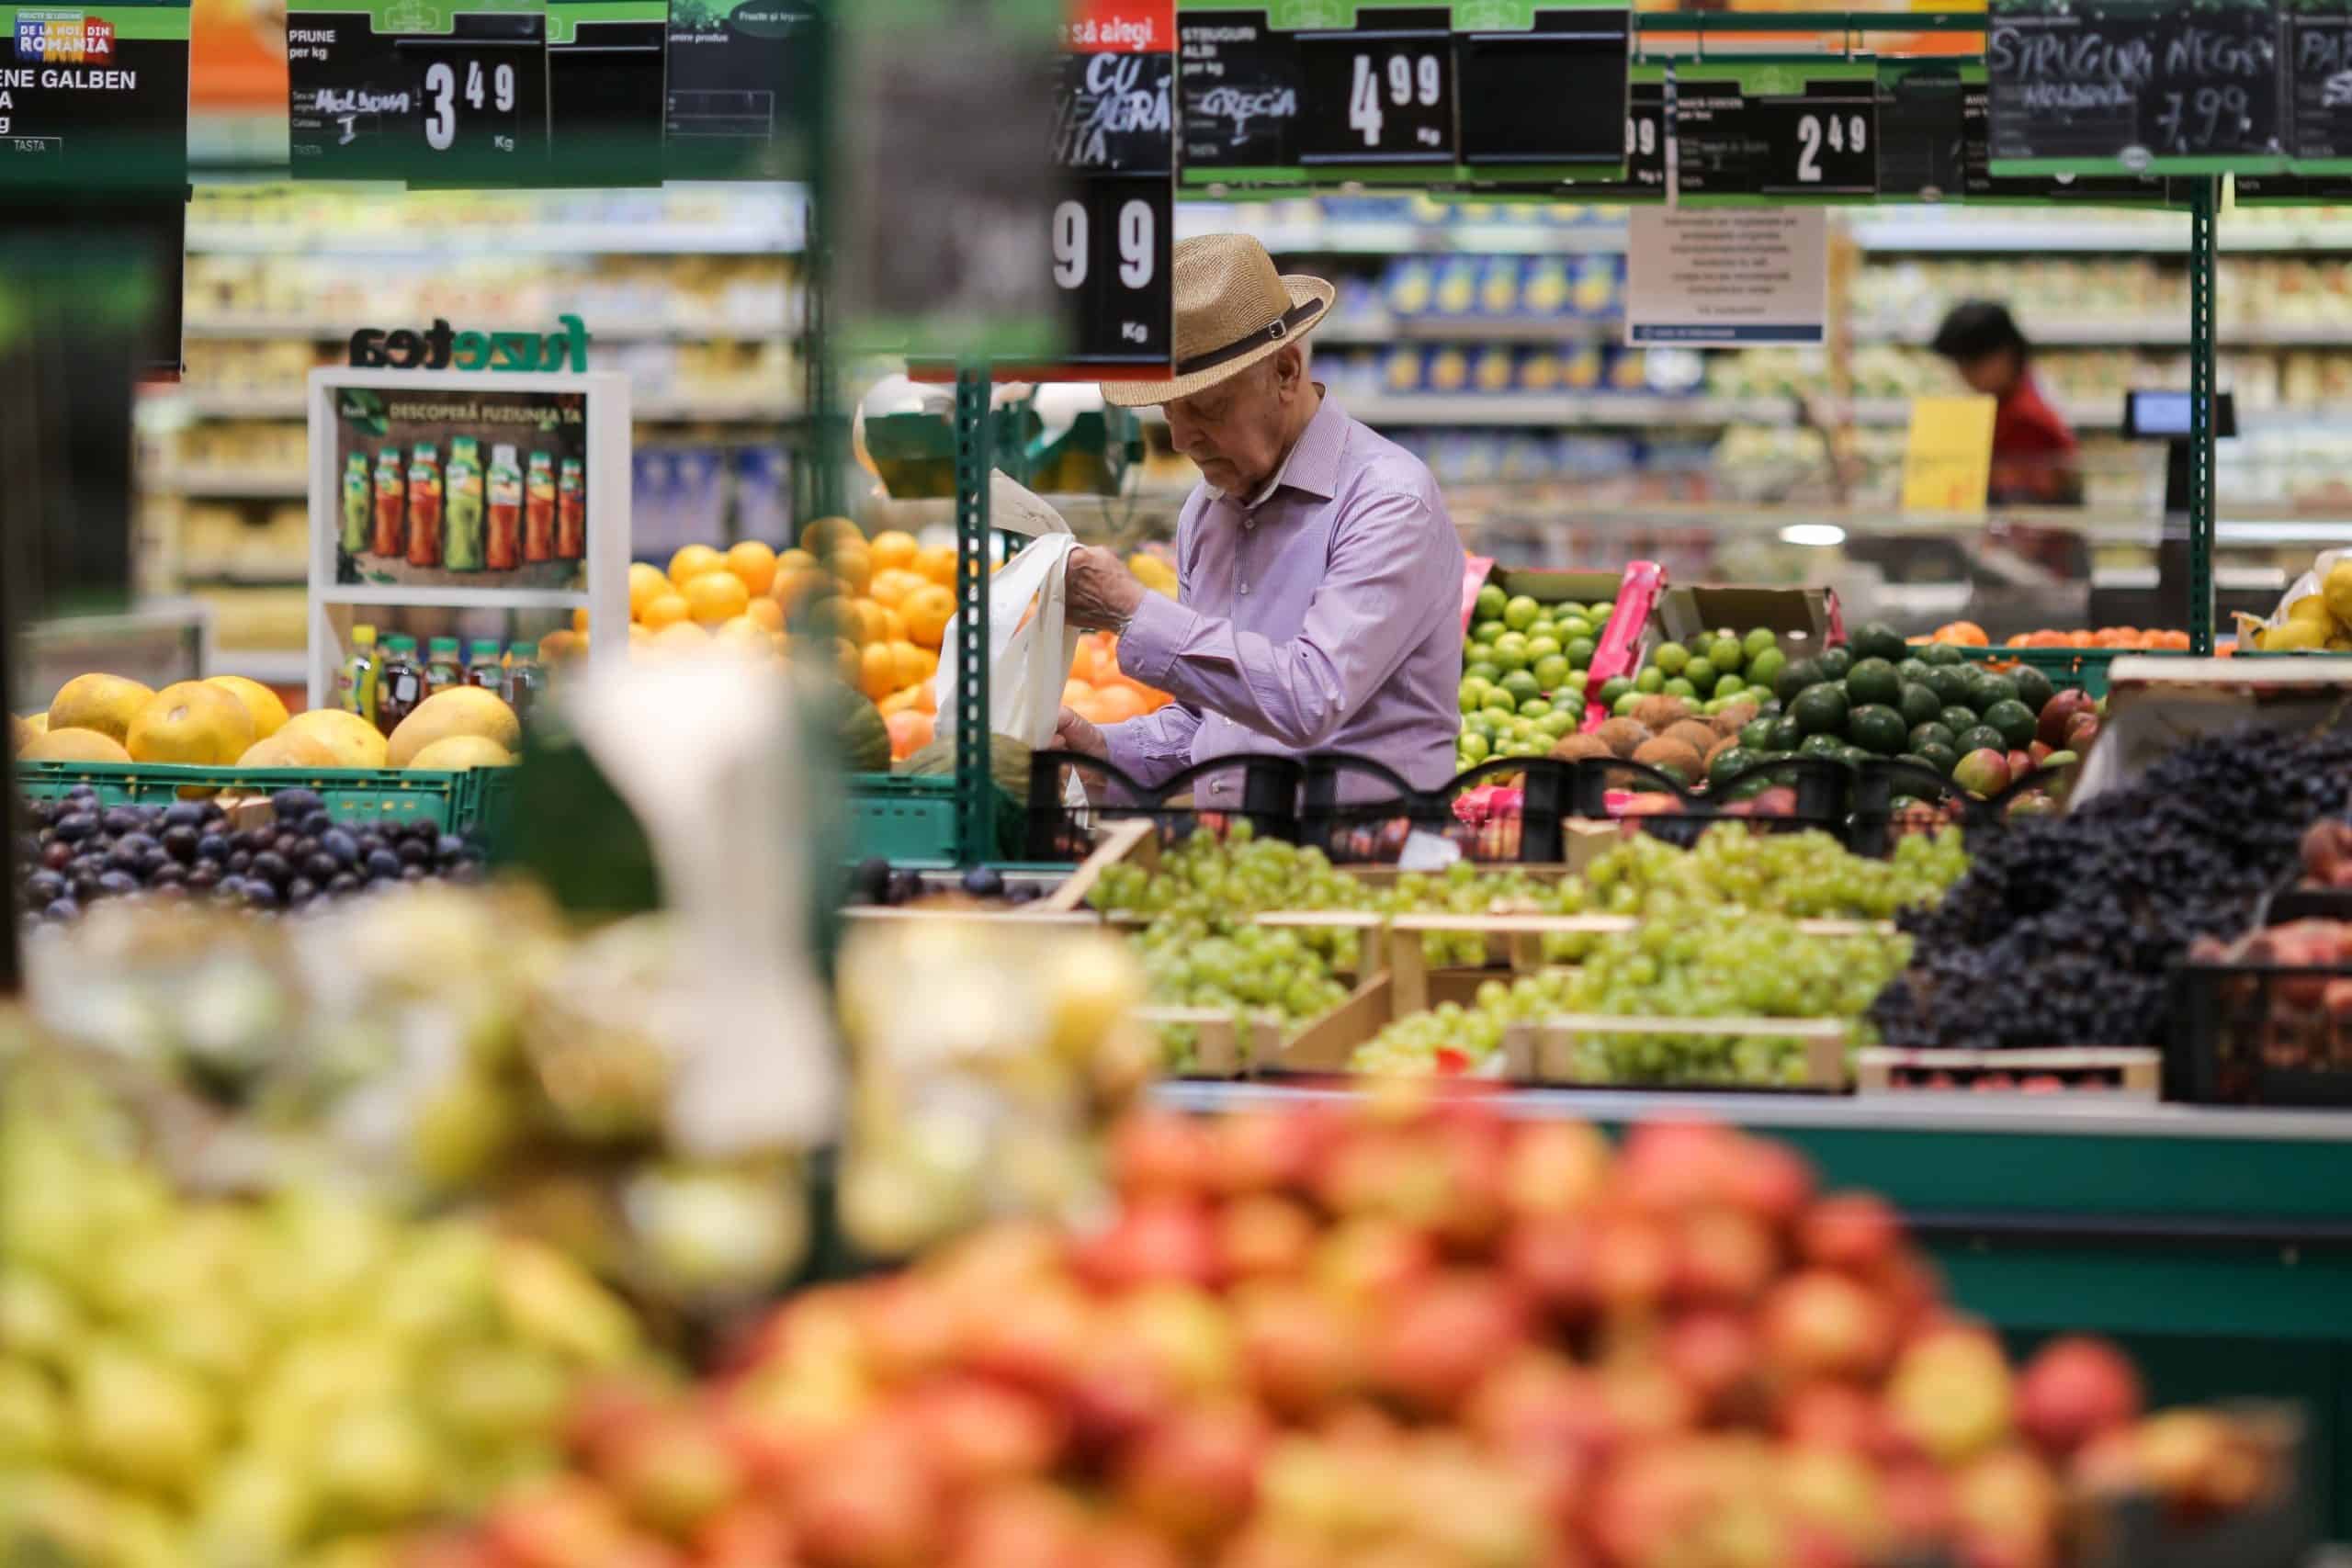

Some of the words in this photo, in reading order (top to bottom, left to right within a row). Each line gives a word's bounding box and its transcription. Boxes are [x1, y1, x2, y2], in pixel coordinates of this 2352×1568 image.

[20, 25, 35, 35] DE
[39, 25, 53, 35] LA
[87, 26, 110, 36] DIN
[288, 29, 336, 43] PRUNE
[289, 48, 310, 60] per
[311, 46, 328, 61] kg
[40, 70, 137, 89] GALBEN
[1086, 52, 1143, 96] CU
[14, 140, 45, 152] TASTA
[493, 135, 514, 152] Kg
